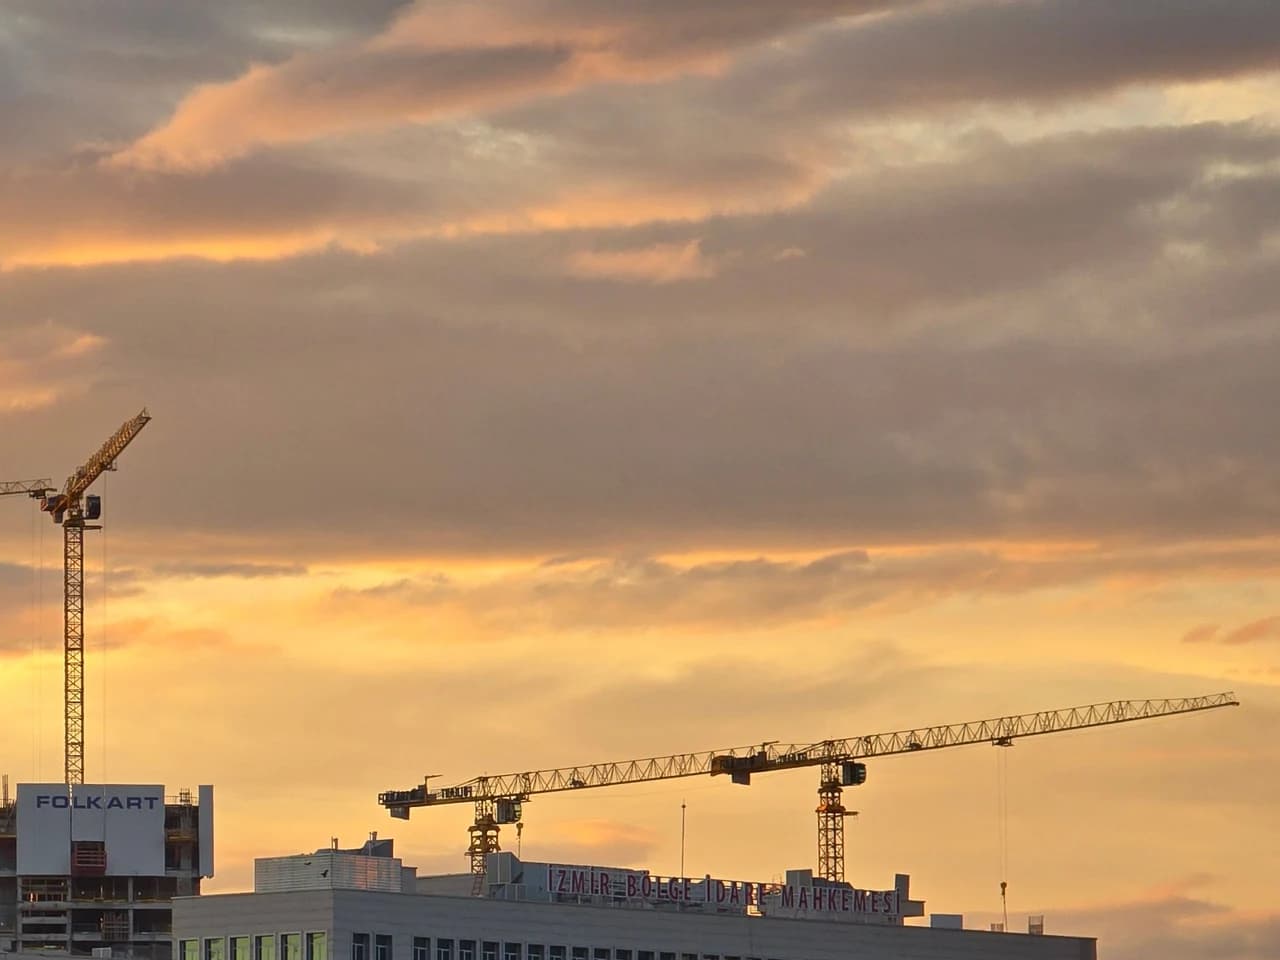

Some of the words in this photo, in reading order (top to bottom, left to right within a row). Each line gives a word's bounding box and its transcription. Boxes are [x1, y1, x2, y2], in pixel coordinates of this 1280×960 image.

[36, 795, 159, 810] FOLKART
[548, 864, 610, 896] İZMİR
[627, 870, 692, 900] BÖLGE
[705, 874, 767, 906] İDARE
[781, 884, 901, 914] MAHKEMESİ
